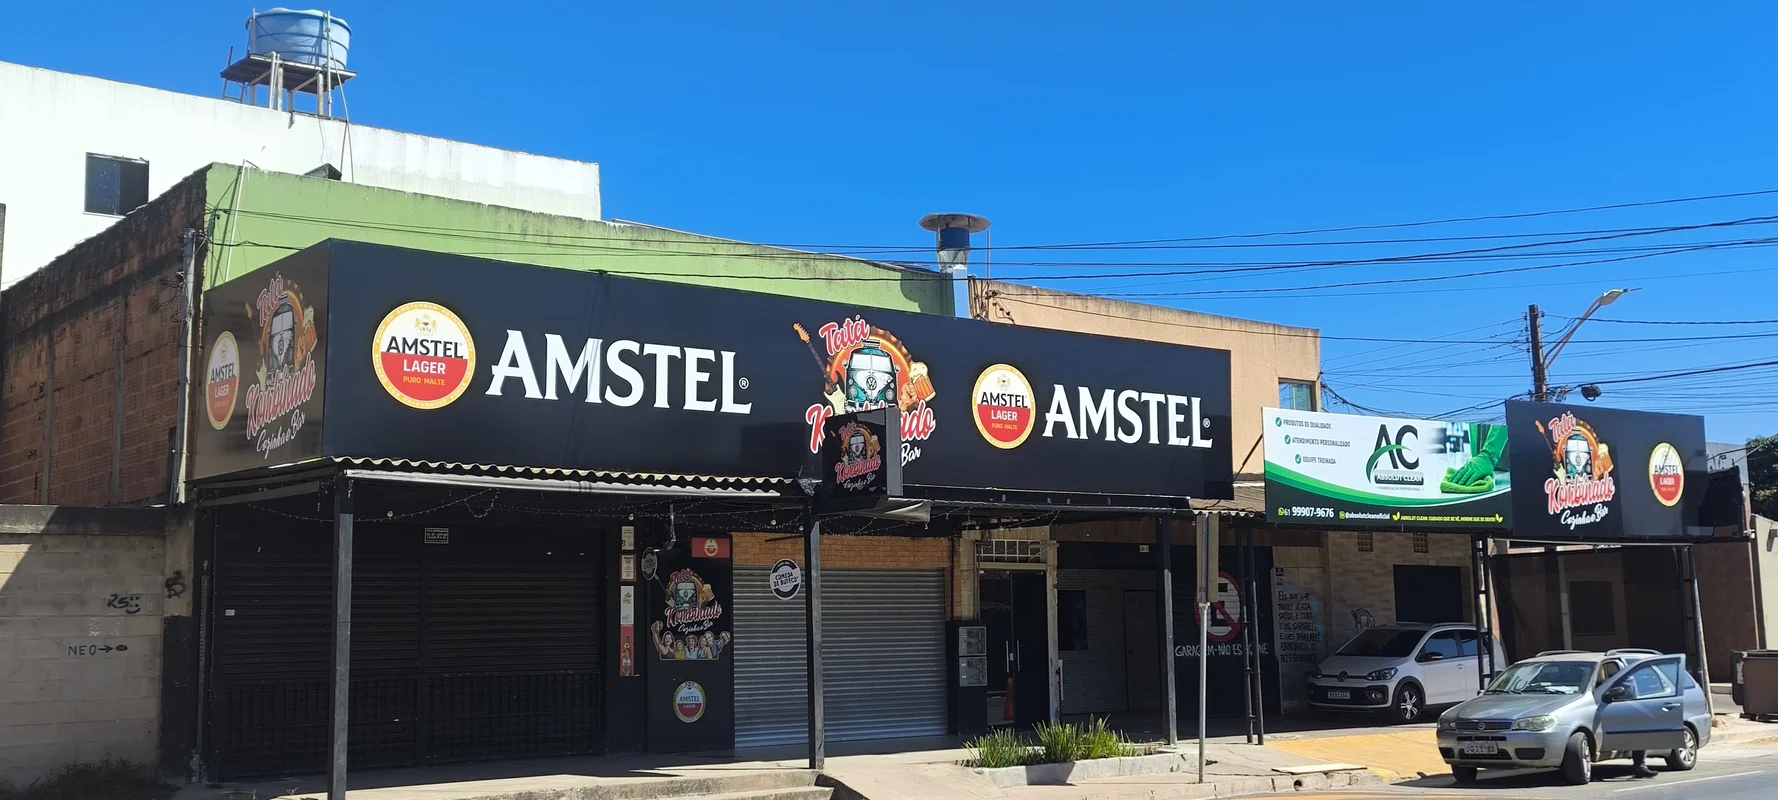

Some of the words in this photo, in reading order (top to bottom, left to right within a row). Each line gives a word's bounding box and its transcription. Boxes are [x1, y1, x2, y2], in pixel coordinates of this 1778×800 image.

[257, 271, 283, 326] Tatá
[819, 314, 870, 356] Tatá
[386, 336, 463, 359] AMSTEL
[211, 362, 235, 383] AMSTEL
[404, 359, 446, 374] LAGER
[485, 329, 752, 414] AMSTEL
[403, 376, 421, 384] PURO
[424, 377, 446, 386] MALTE
[214, 384, 229, 398] LAGER
[246, 351, 316, 440] Kombinado
[980, 392, 1028, 408] AMSTEL
[991, 410, 1017, 421] LAGER
[1042, 383, 1213, 449] AMSTEL
[1283, 419, 1304, 427] PRODUTOS
[257, 427, 286, 459] Cozinha
[291, 409, 305, 440] Bar
[1548, 410, 1576, 442] Tatá
[1292, 437, 1319, 445] ATENDIMENTO
[1320, 439, 1351, 447] PERSONALIZADO
[1373, 424, 1419, 470] AC
[1654, 464, 1679, 475] AMSTEL
[1659, 477, 1675, 486] LAGER
[1545, 471, 1615, 515] Kombinado
[1292, 506, 1334, 518] 99907-9676
[1561, 510, 1591, 530] Cozinha
[1594, 503, 1609, 522] Bar
[106, 593, 129, 609] RS
[68, 644, 97, 656] NEO
